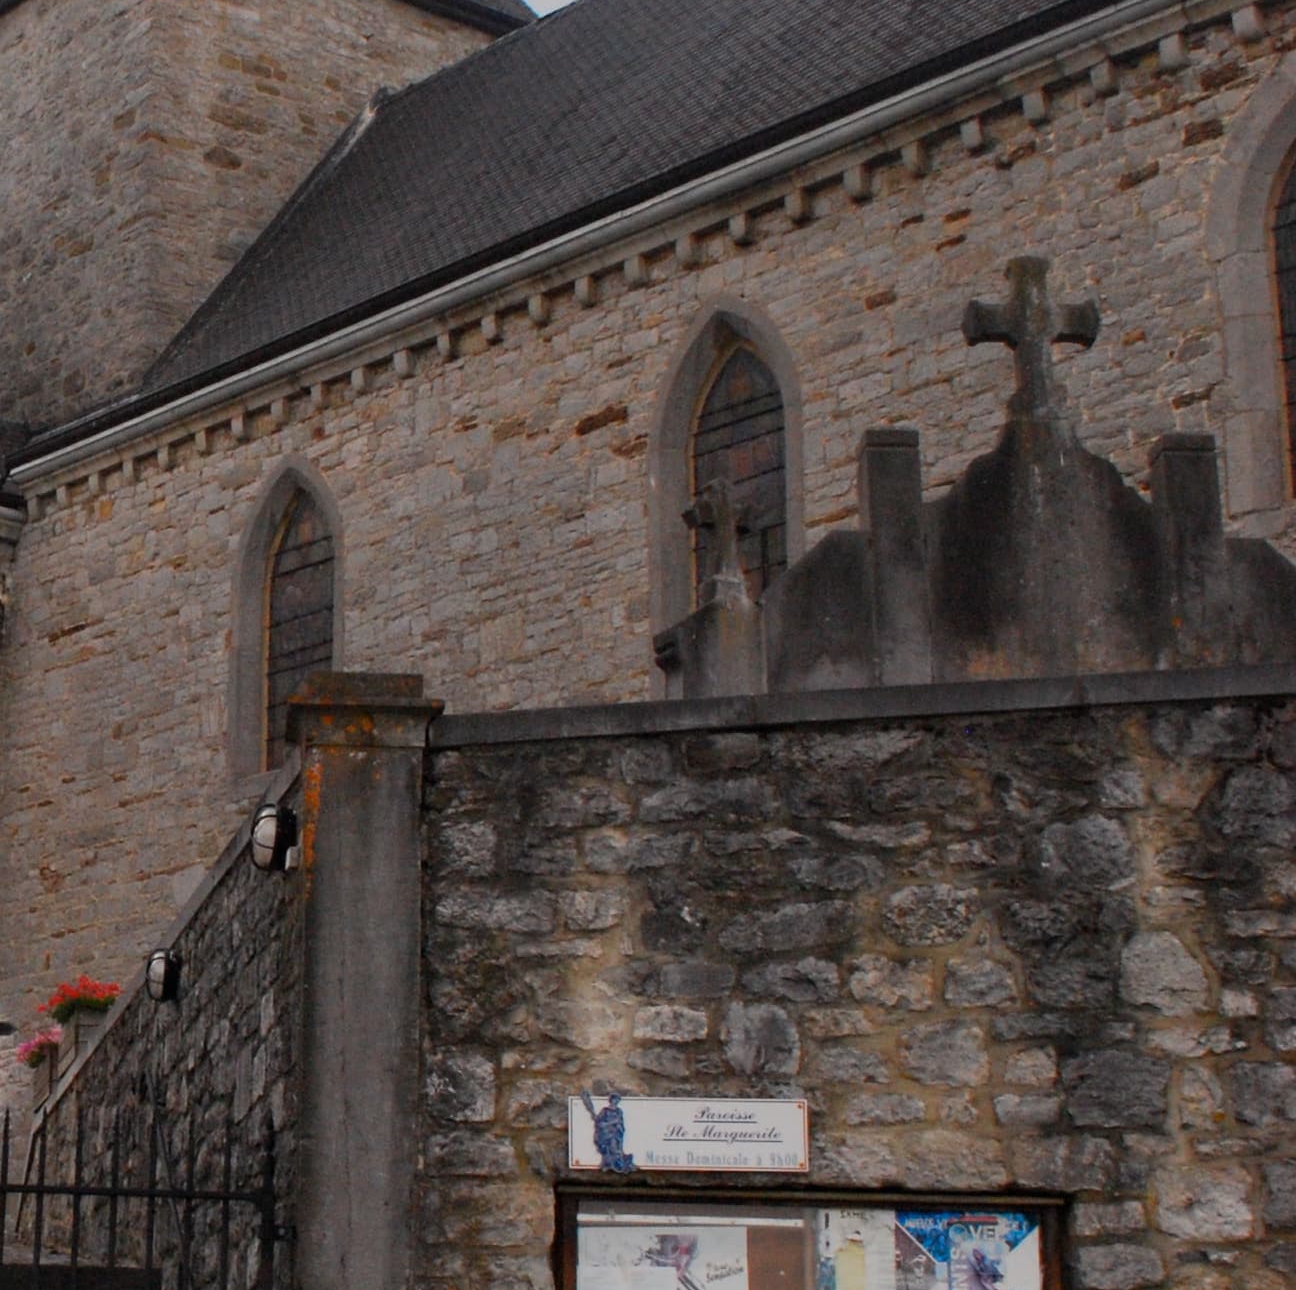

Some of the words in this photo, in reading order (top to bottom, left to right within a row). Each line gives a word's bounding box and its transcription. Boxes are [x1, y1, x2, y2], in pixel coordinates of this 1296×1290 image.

[694, 1105, 755, 1120] Paroisse
[664, 1124, 688, 1139] Ste
[694, 1124, 781, 1145] Marguerite
[646, 1150, 679, 1165] Messe
[687, 1150, 748, 1166] Dominicale
